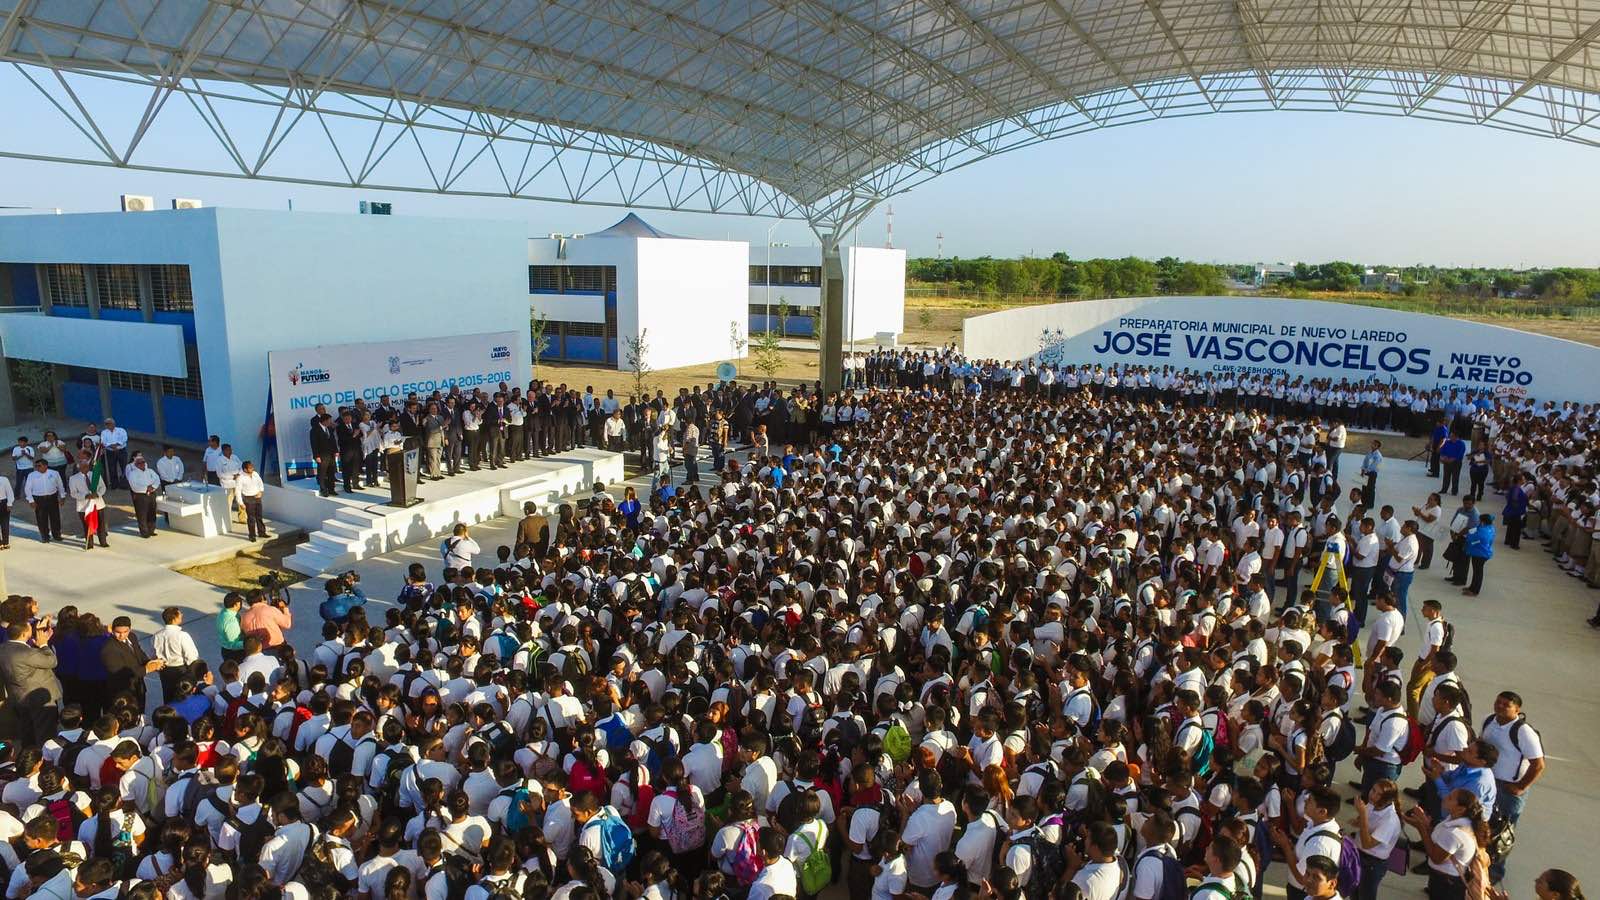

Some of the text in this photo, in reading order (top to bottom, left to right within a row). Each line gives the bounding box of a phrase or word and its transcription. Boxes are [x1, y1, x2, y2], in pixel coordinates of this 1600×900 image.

[1120, 318, 1407, 343] PREPARATORIA MUNICIPAL DE NUEVO LAREDO
[1093, 329, 1431, 375] JOSÉ VASCONCELOS
[1450, 352, 1521, 368] NUEVO
[301, 373, 330, 382] FUTURO
[1437, 364, 1532, 385] LAREDO
[290, 393, 332, 409] INICIO
[335, 390, 355, 404] DEL
[363, 385, 399, 400] CICLO
[402, 378, 456, 395] ESCOLAR
[459, 371, 511, 387] 2015-2016
[1495, 384, 1527, 395] Cambio
